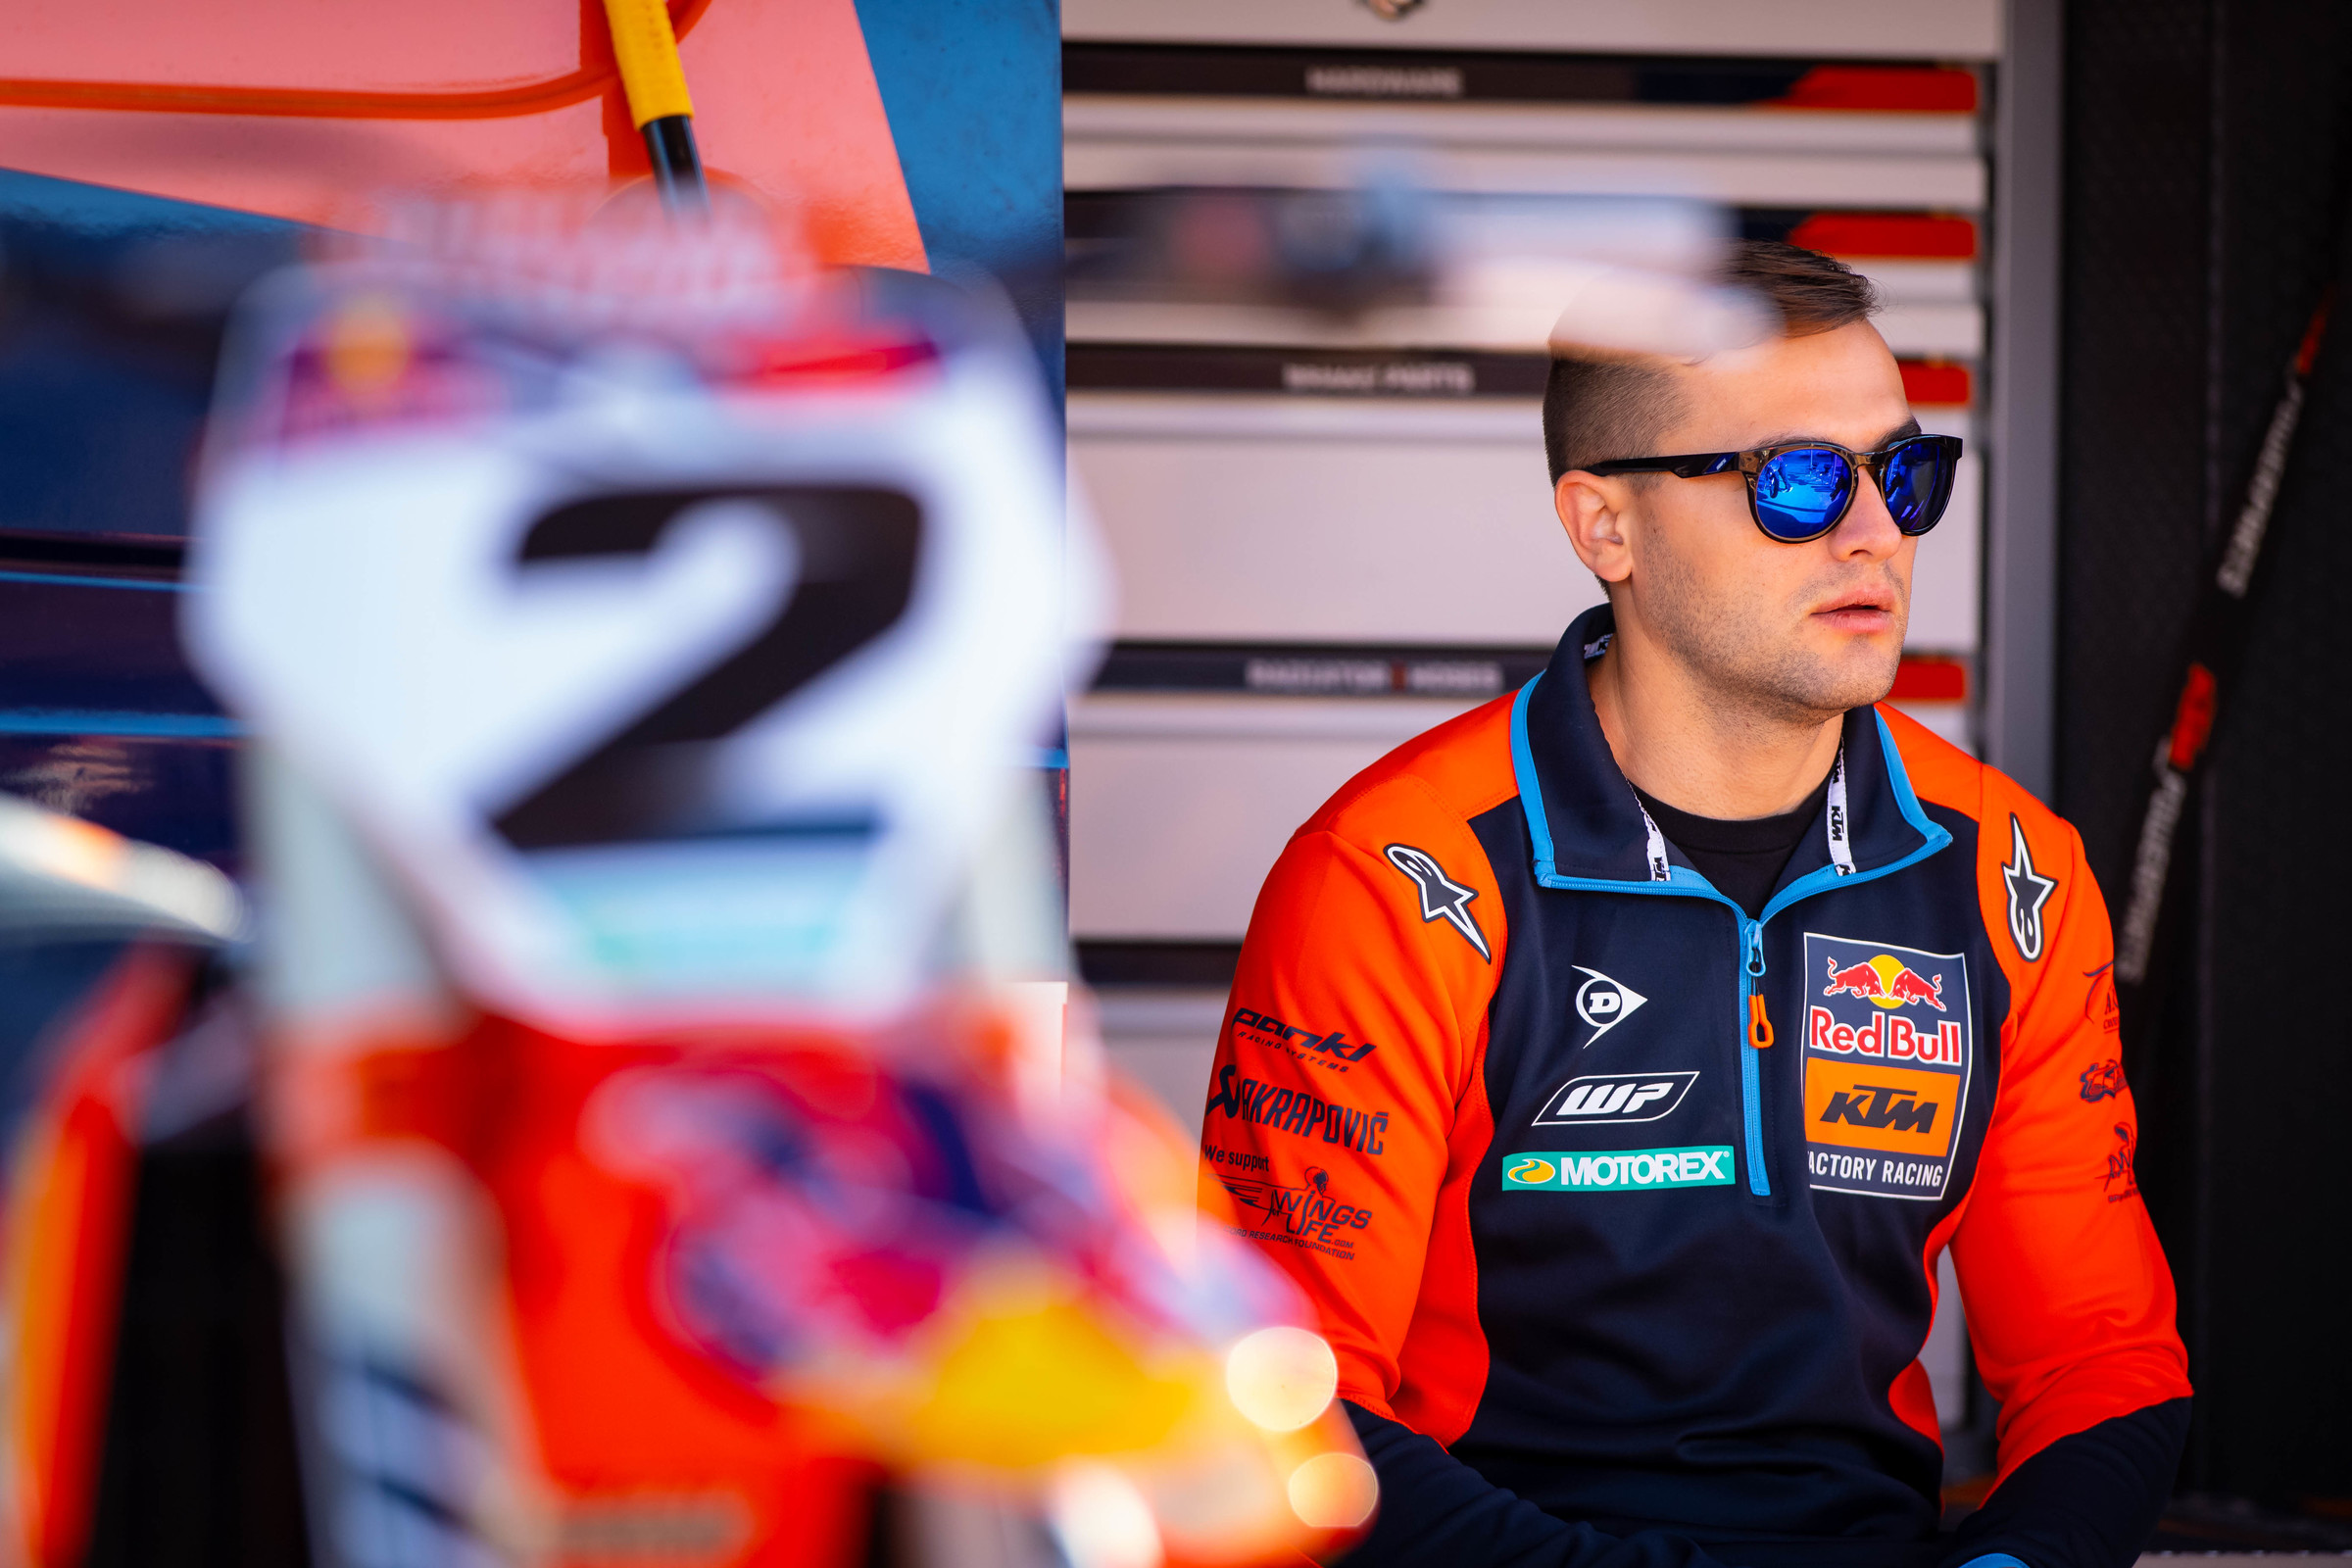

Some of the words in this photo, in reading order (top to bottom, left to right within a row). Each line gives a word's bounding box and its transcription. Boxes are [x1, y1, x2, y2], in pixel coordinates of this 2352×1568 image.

[480, 480, 926, 851] 2
[1831, 806, 1845, 842] KTM
[1238, 1031, 1282, 1050] RACING
[1808, 1004, 1884, 1058] Red
[1889, 1013, 1962, 1066] Bull
[1556, 1082, 1674, 1116] WP
[1820, 1084, 1939, 1134] KTM
[1204, 1144, 1225, 1163] We
[1228, 1151, 1270, 1172] support
[1561, 1152, 1722, 1186] MOTOREX
[1808, 1150, 1877, 1181] ACTORY
[1882, 1160, 1943, 1188] RACING
[1249, 1231, 1294, 1246] RESEARCH
[1294, 1238, 1354, 1261] FOUNDATION
